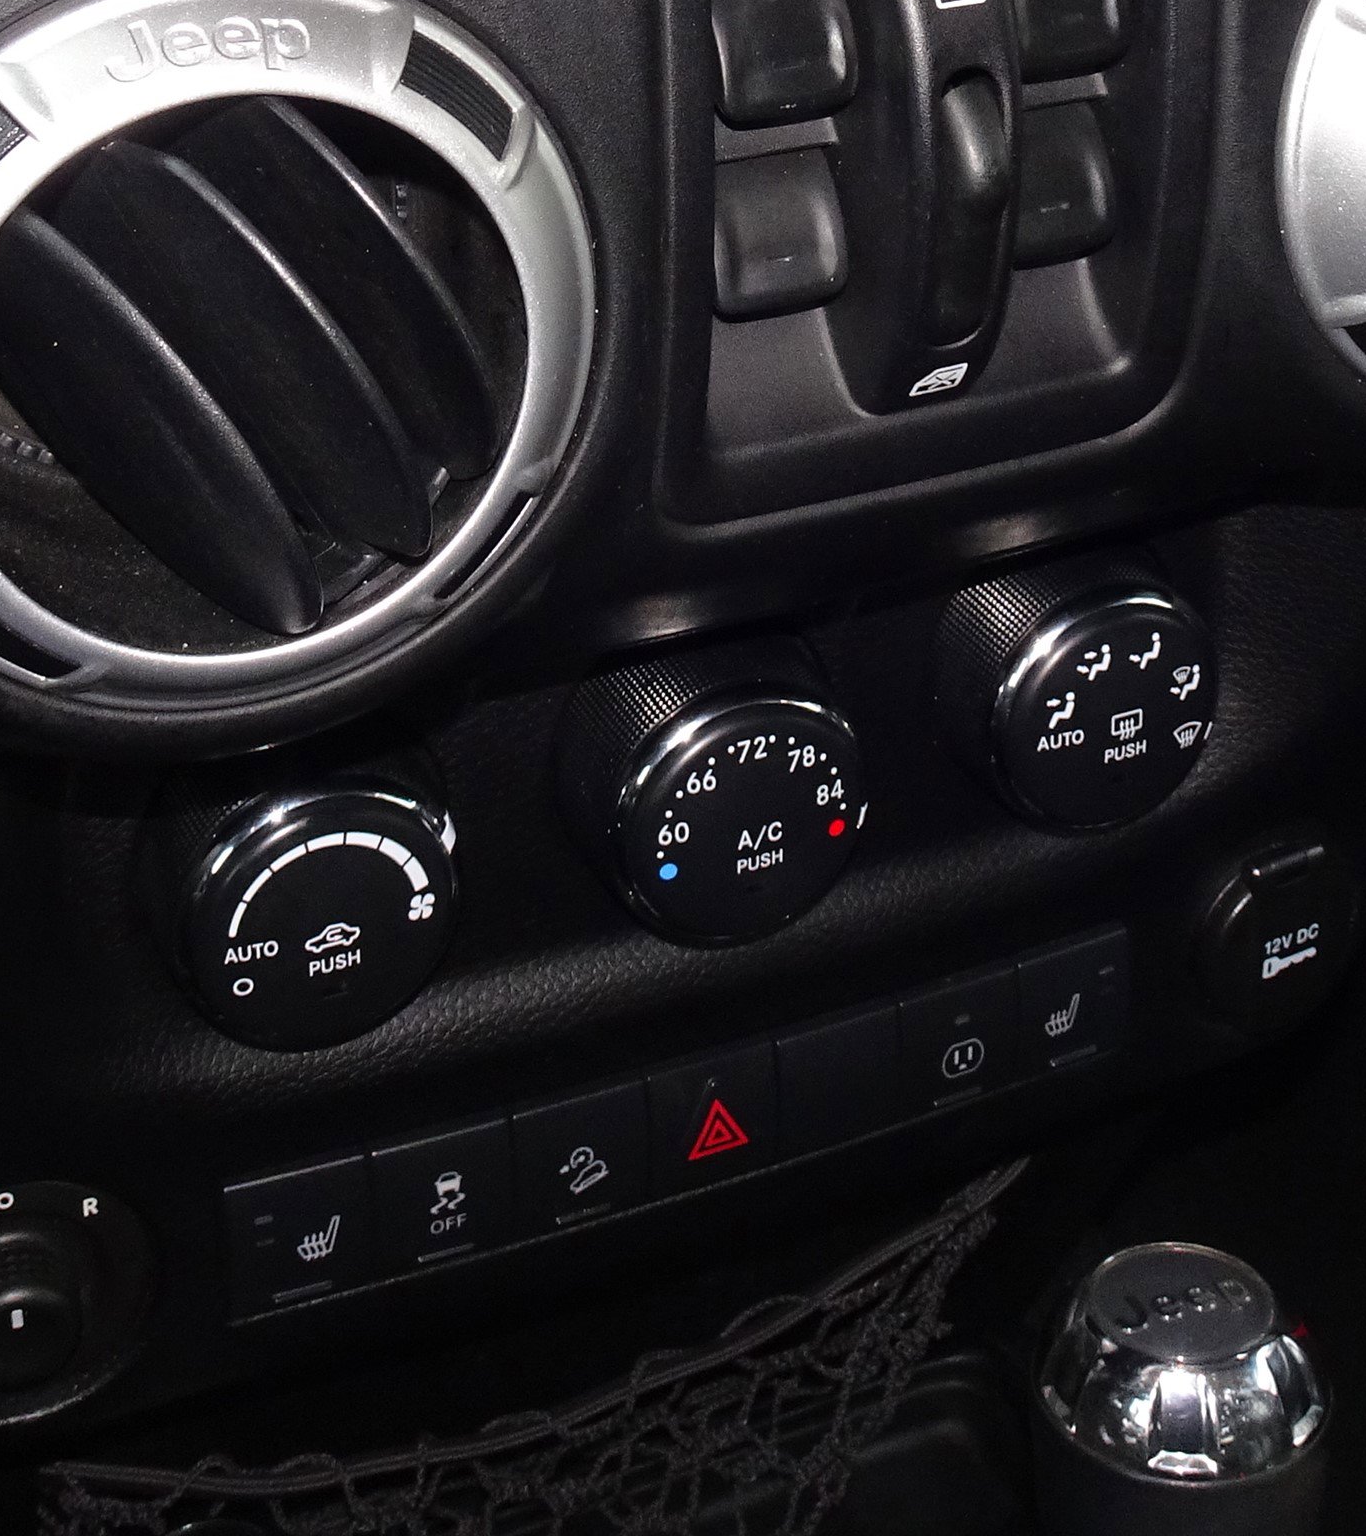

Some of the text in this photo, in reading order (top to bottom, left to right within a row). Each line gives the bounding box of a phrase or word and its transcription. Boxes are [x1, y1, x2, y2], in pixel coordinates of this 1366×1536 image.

[103, 15, 311, 83] Jeep
[736, 735, 769, 765] 72
[1036, 728, 1086, 753] AUTO
[1103, 739, 1148, 765] PUSH
[786, 744, 817, 774] 78
[685, 767, 718, 795] 66
[815, 777, 845, 806] 84
[657, 821, 691, 847] 60
[737, 820, 785, 852] A/C
[736, 848, 785, 875] PUSH
[223, 939, 280, 966] AUTO
[1263, 922, 1320, 955] 12V DC
[308, 948, 362, 978] PUSH
[81, 1196, 100, 1218] R
[429, 1211, 467, 1235] OFF
